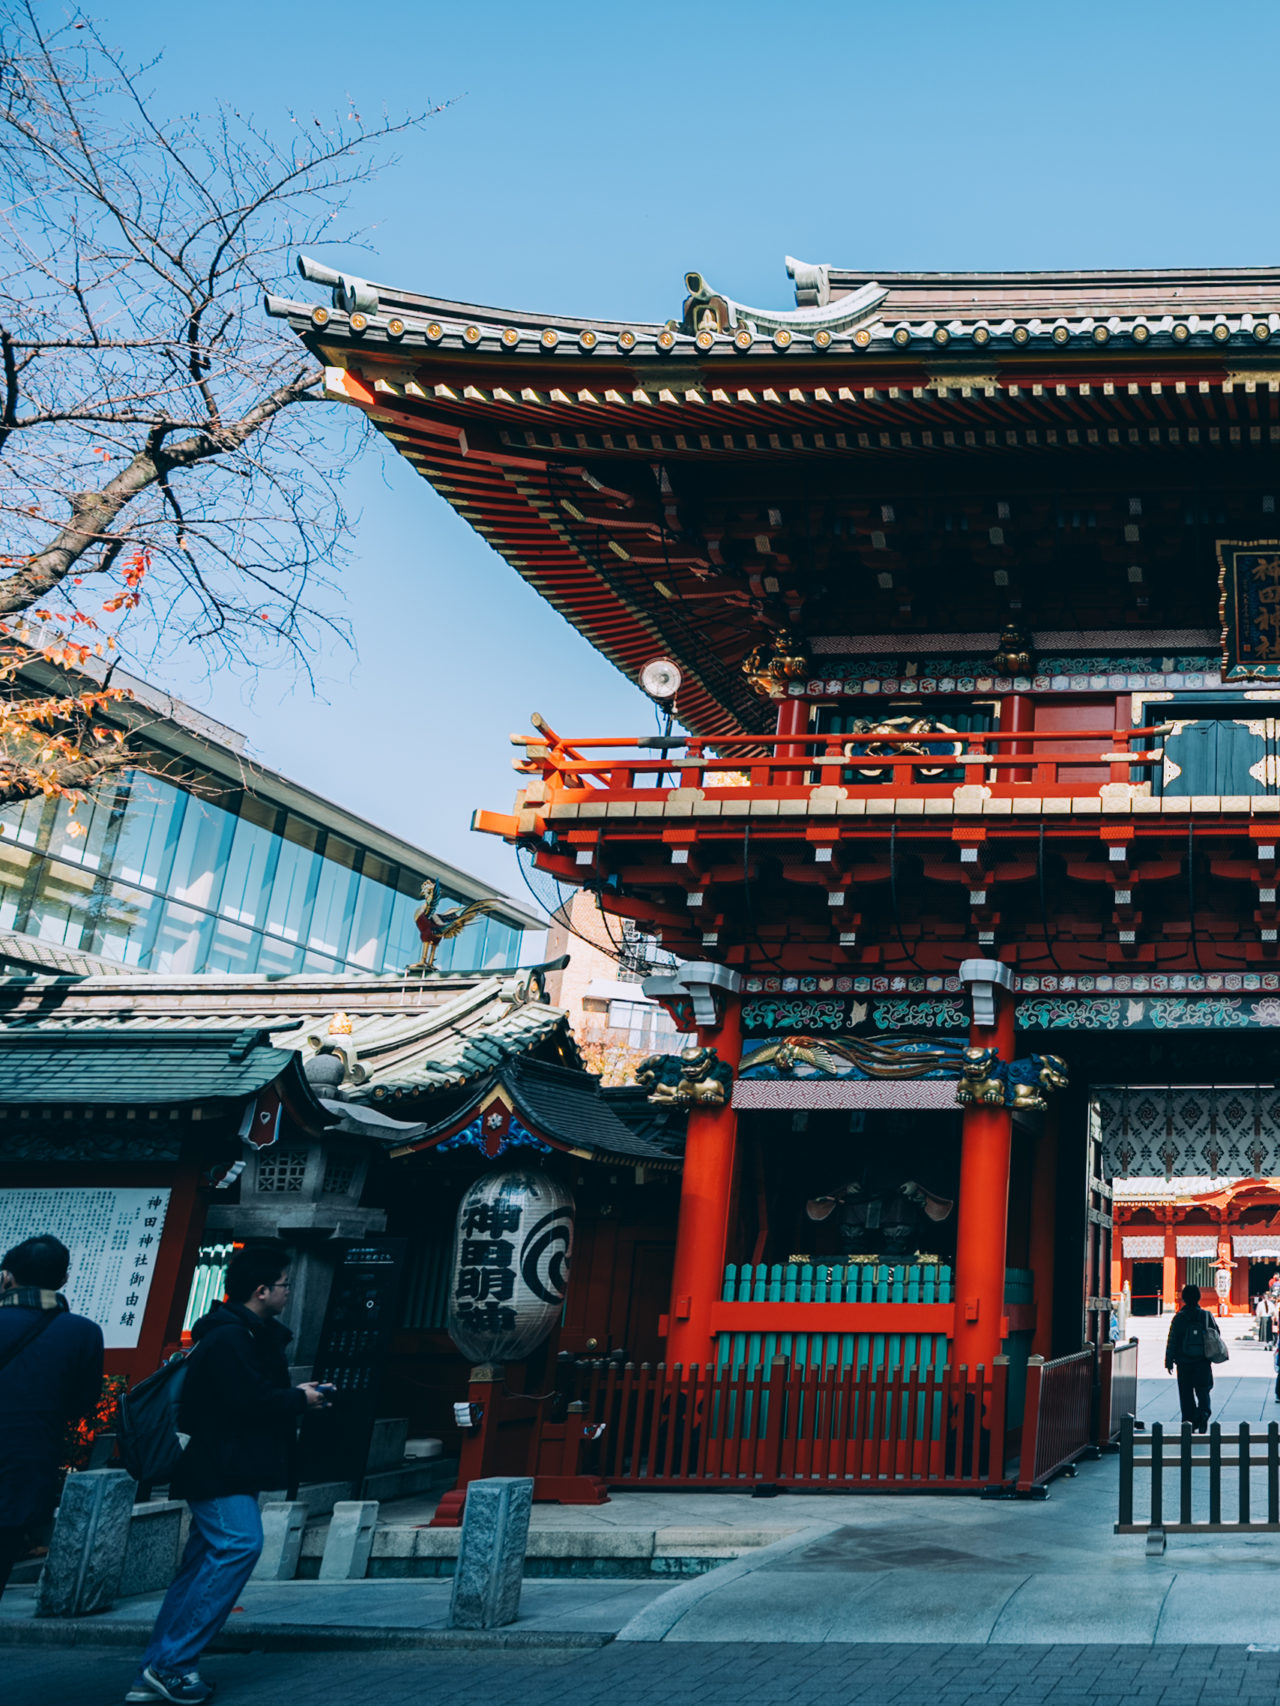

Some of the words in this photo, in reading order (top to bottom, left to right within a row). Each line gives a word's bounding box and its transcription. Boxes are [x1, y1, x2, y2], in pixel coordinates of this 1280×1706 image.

[119, 1195, 163, 1327] 神田神社御由緒
[455, 1198, 523, 1334] 神田明神
